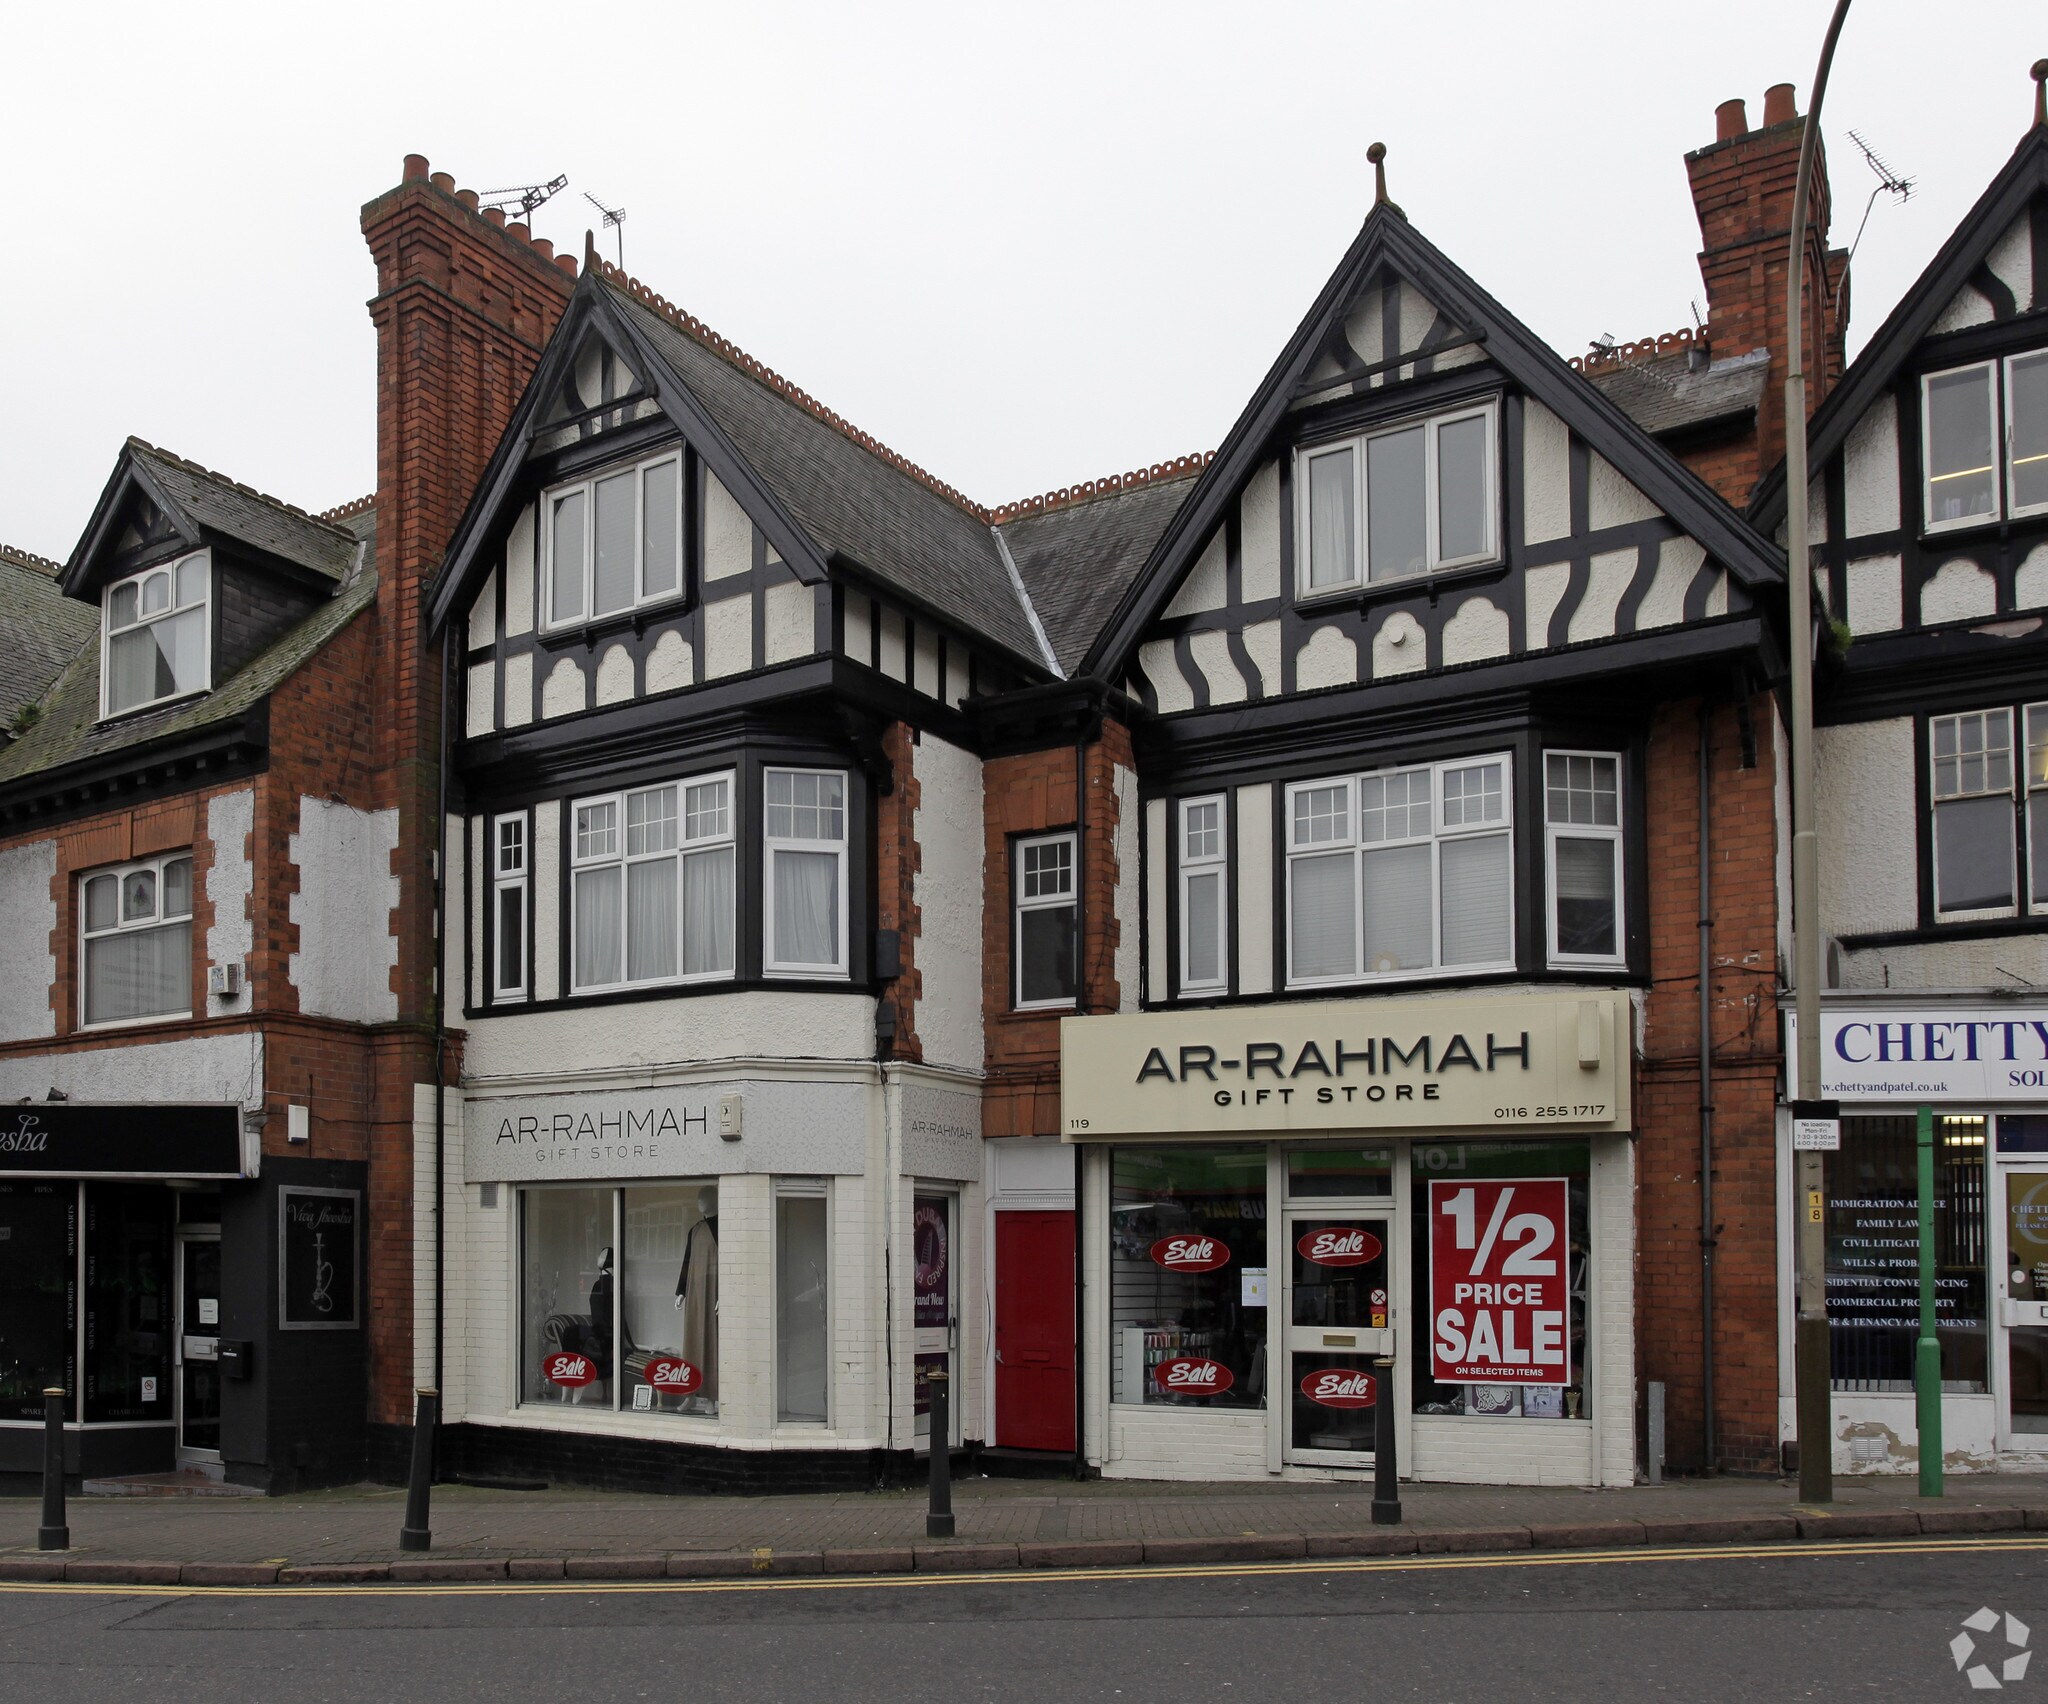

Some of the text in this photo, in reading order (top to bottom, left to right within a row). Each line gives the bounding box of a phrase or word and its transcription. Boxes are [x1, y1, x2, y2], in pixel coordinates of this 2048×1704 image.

[1135, 1031, 1529, 1083] AR-RAHMAH
[2008, 1070, 2048, 1087] SOL
[1213, 1083, 1440, 1107] GIFT STORE
[1494, 1105, 1605, 1118] 0116 255 1717
[495, 1106, 707, 1145] AR-RAHMAH
[911, 1121, 973, 1139] AR-RAHMAH
[1070, 1119, 1090, 1129] 119
[536, 1144, 659, 1161] GIFT STORE
[1813, 1195, 1819, 1204] 1
[1830, 1200, 1947, 1209] IMMIGRATION ADCE
[287, 1201, 314, 1222] Viva
[1813, 1210, 1821, 1220] 8
[1856, 1219, 1896, 1228] FAMILY
[1164, 1239, 1214, 1261] Sale
[1312, 1232, 1365, 1255] Sale
[1842, 1239, 1920, 1248] CIVIL LITIGATI
[1843, 1259, 1876, 1268] WILLS
[1878, 1259, 1886, 1267] &
[1884, 1279, 1969, 1288] CONVENCING
[1455, 1283, 1543, 1305] PRICE
[1825, 1298, 1957, 1307] COMMERCIAL PRORTY
[1842, 1318, 1850, 1326] &
[1852, 1318, 1902, 1327] TENANCY
[1903, 1318, 1977, 1327] AGEMENTS
[1435, 1308, 1564, 1365] SALE
[552, 1357, 586, 1376] Sale
[654, 1363, 691, 1382] Sale
[1168, 1362, 1218, 1383] Sale
[1455, 1366, 1544, 1377] ON SELECTED ITEMS
[1315, 1374, 1369, 1395] Sale
[21, 1408, 42, 1416] SPARE
